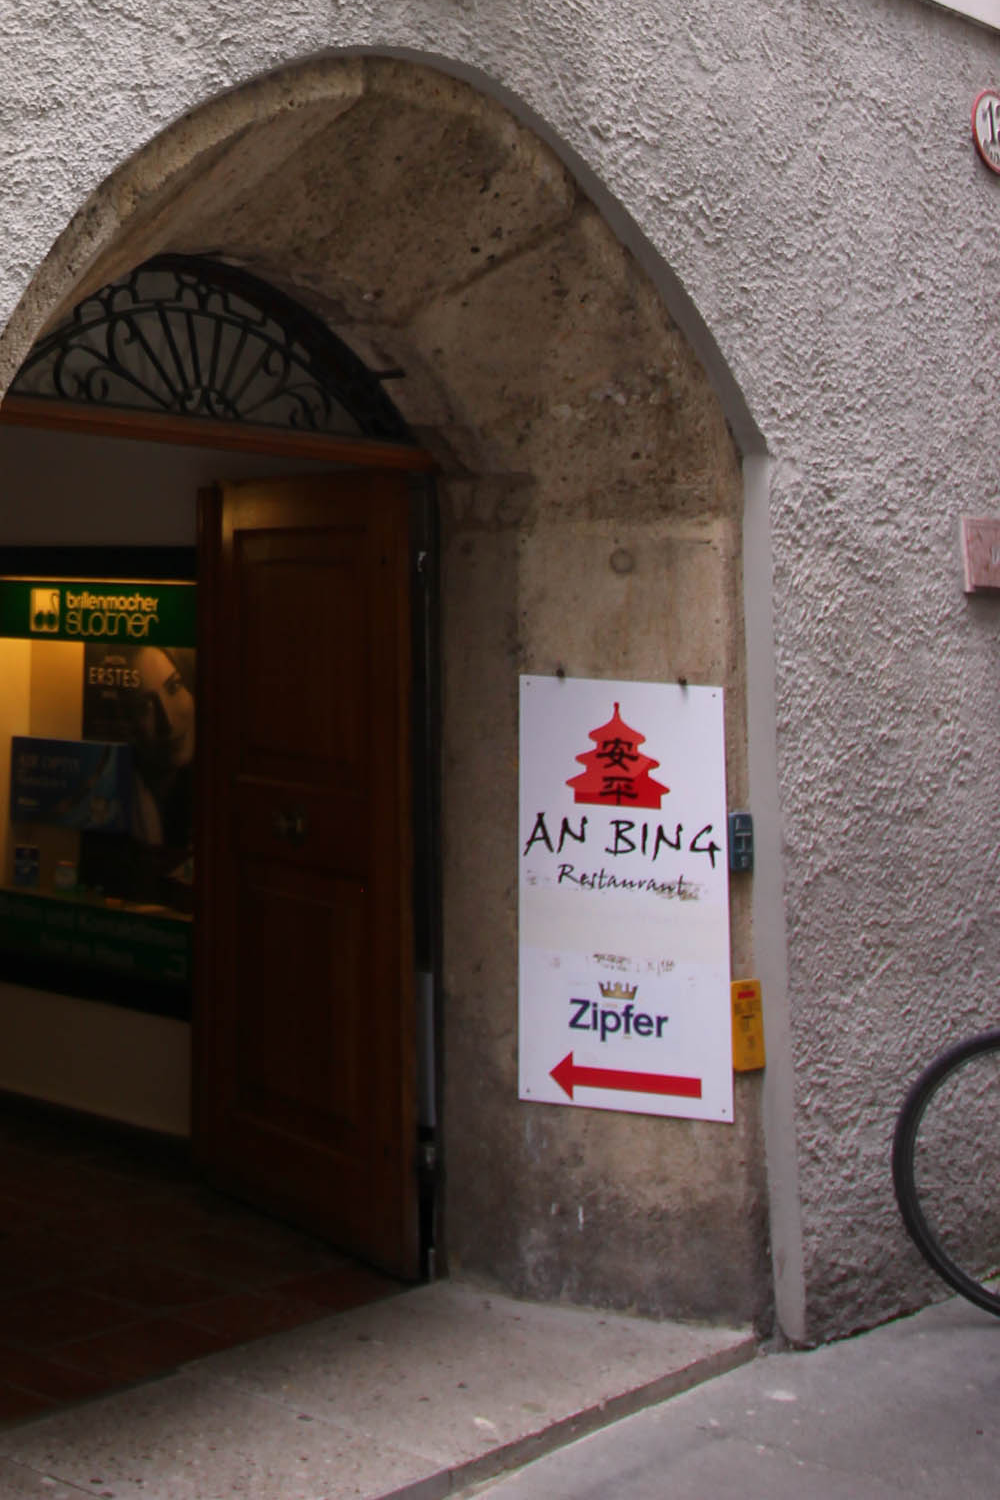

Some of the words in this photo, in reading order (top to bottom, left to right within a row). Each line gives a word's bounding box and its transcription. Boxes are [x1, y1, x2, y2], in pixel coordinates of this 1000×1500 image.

[65, 590, 160, 612] brillenmacher
[88, 666, 141, 689] ERSTES
[595, 737, 640, 805] 安平
[523, 811, 588, 857] AN
[604, 819, 721, 869] BING
[557, 863, 688, 897] Restaurant
[568, 998, 669, 1042] Zipfer
